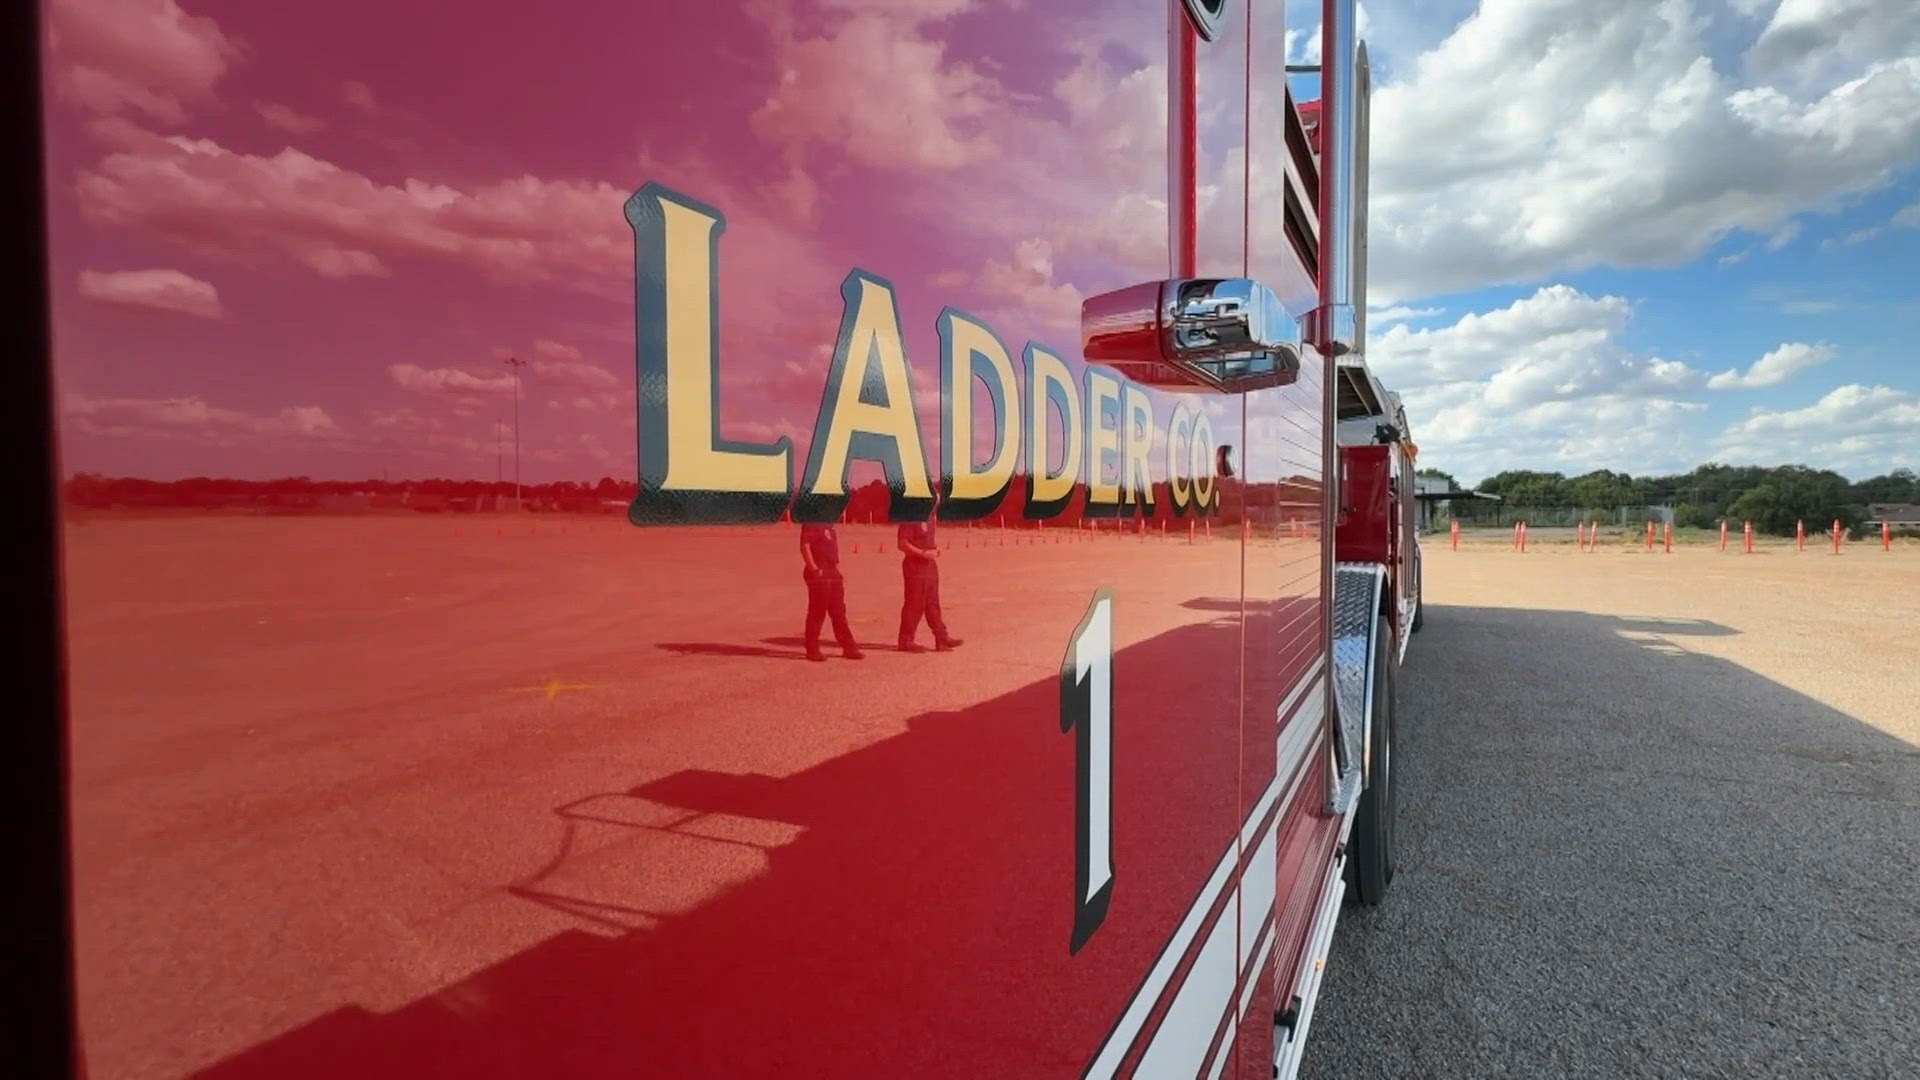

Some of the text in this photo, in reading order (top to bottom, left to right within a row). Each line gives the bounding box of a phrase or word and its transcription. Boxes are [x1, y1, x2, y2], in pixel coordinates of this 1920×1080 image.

[626, 184, 1221, 525] LADDER CO.
[1062, 589, 1113, 950] 1
